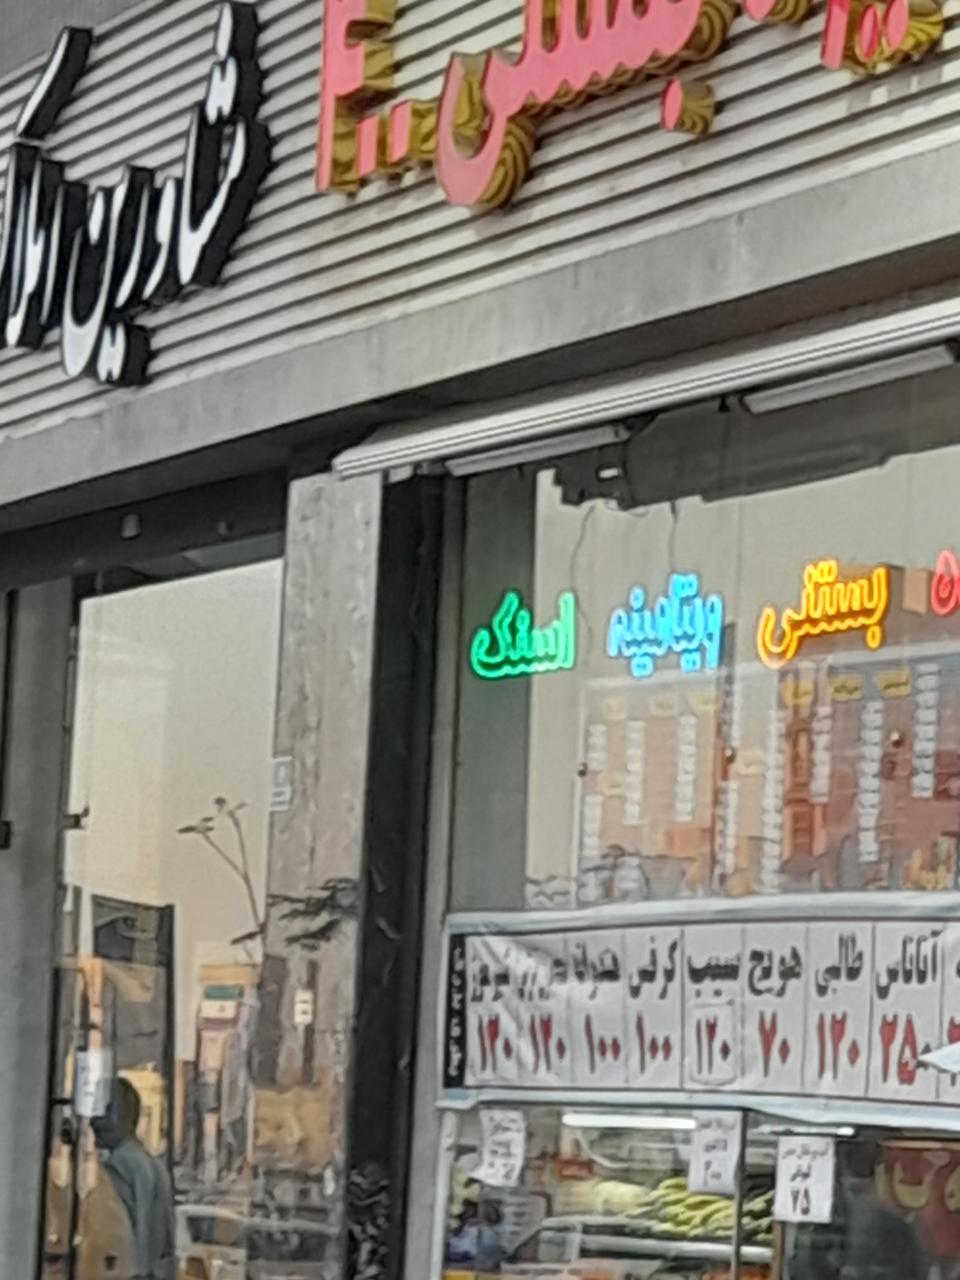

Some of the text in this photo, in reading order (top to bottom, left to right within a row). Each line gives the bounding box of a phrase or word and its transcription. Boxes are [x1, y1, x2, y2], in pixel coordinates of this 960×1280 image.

[470, 588, 577, 679] اسنک
[607, 572, 724, 678] ویتامینه
[758, 559, 888, 669] بستنی
[687, 953, 740, 998] سیب
[748, 945, 802, 998] هویج
[816, 933, 864, 997] طالبی
[876, 930, 943, 1000] آناناس
[585, 1013, 621, 1075] ۱۰۰
[636, 1012, 672, 1075] ۱۰۰
[758, 1011, 790, 1078] ۷۰
[817, 1011, 860, 1081] ۱۲۰
